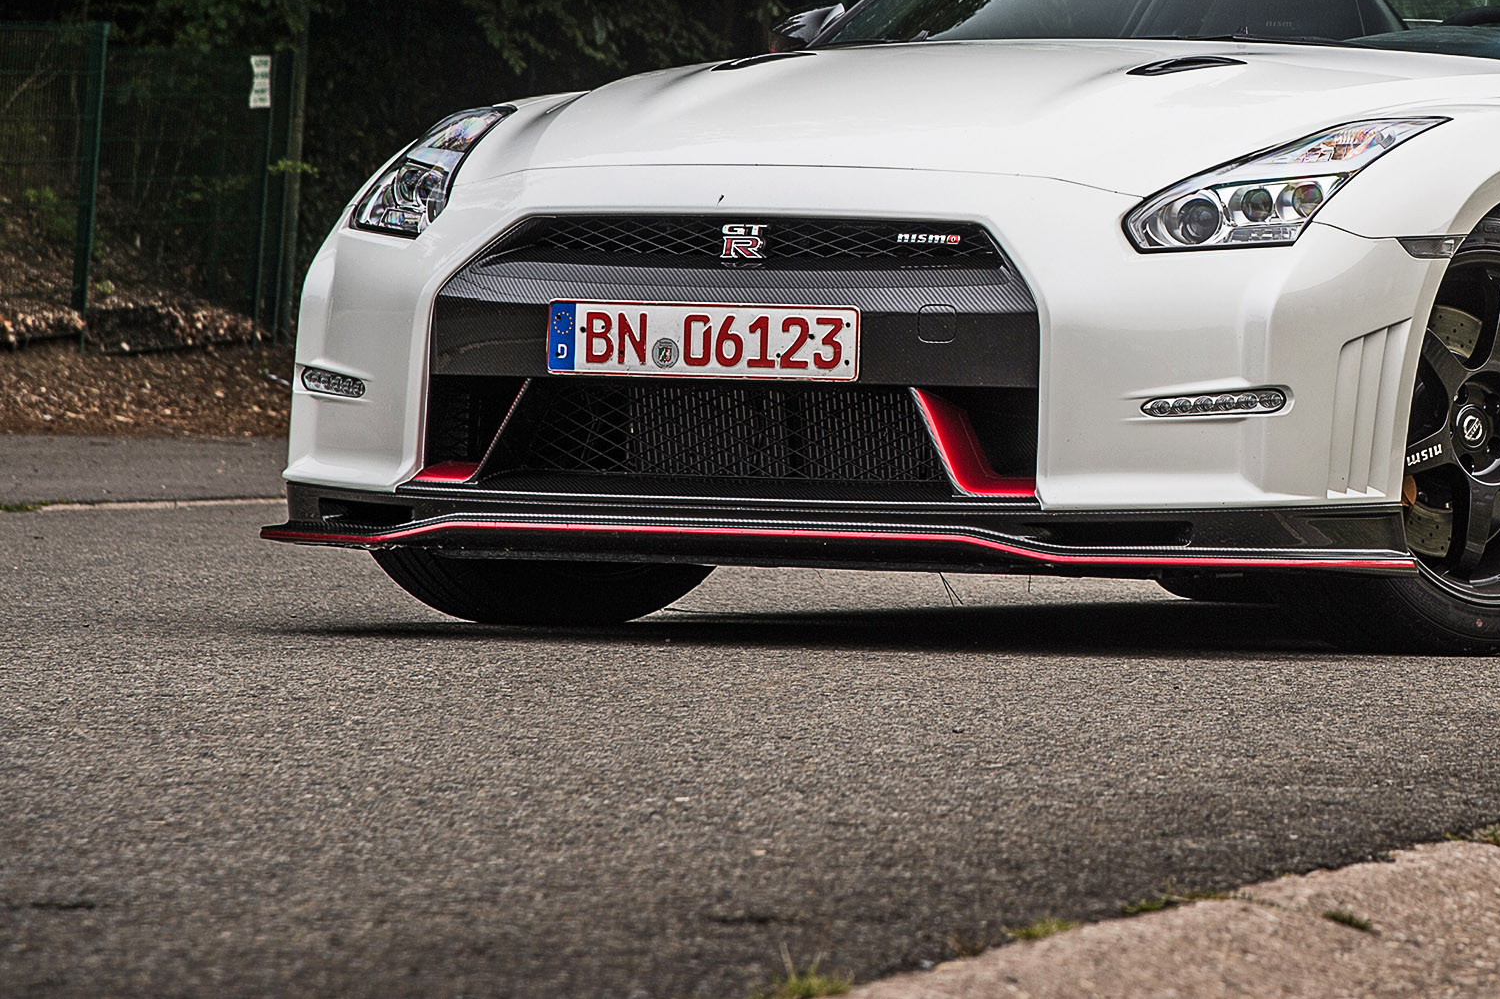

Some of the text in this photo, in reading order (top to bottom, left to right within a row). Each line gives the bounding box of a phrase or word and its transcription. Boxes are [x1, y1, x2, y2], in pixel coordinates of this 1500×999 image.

[721, 223, 768, 236] GT
[719, 235, 765, 259] R
[557, 343, 568, 359] D
[585, 311, 843, 369] BN 06123
[1406, 443, 1443, 467] nism
